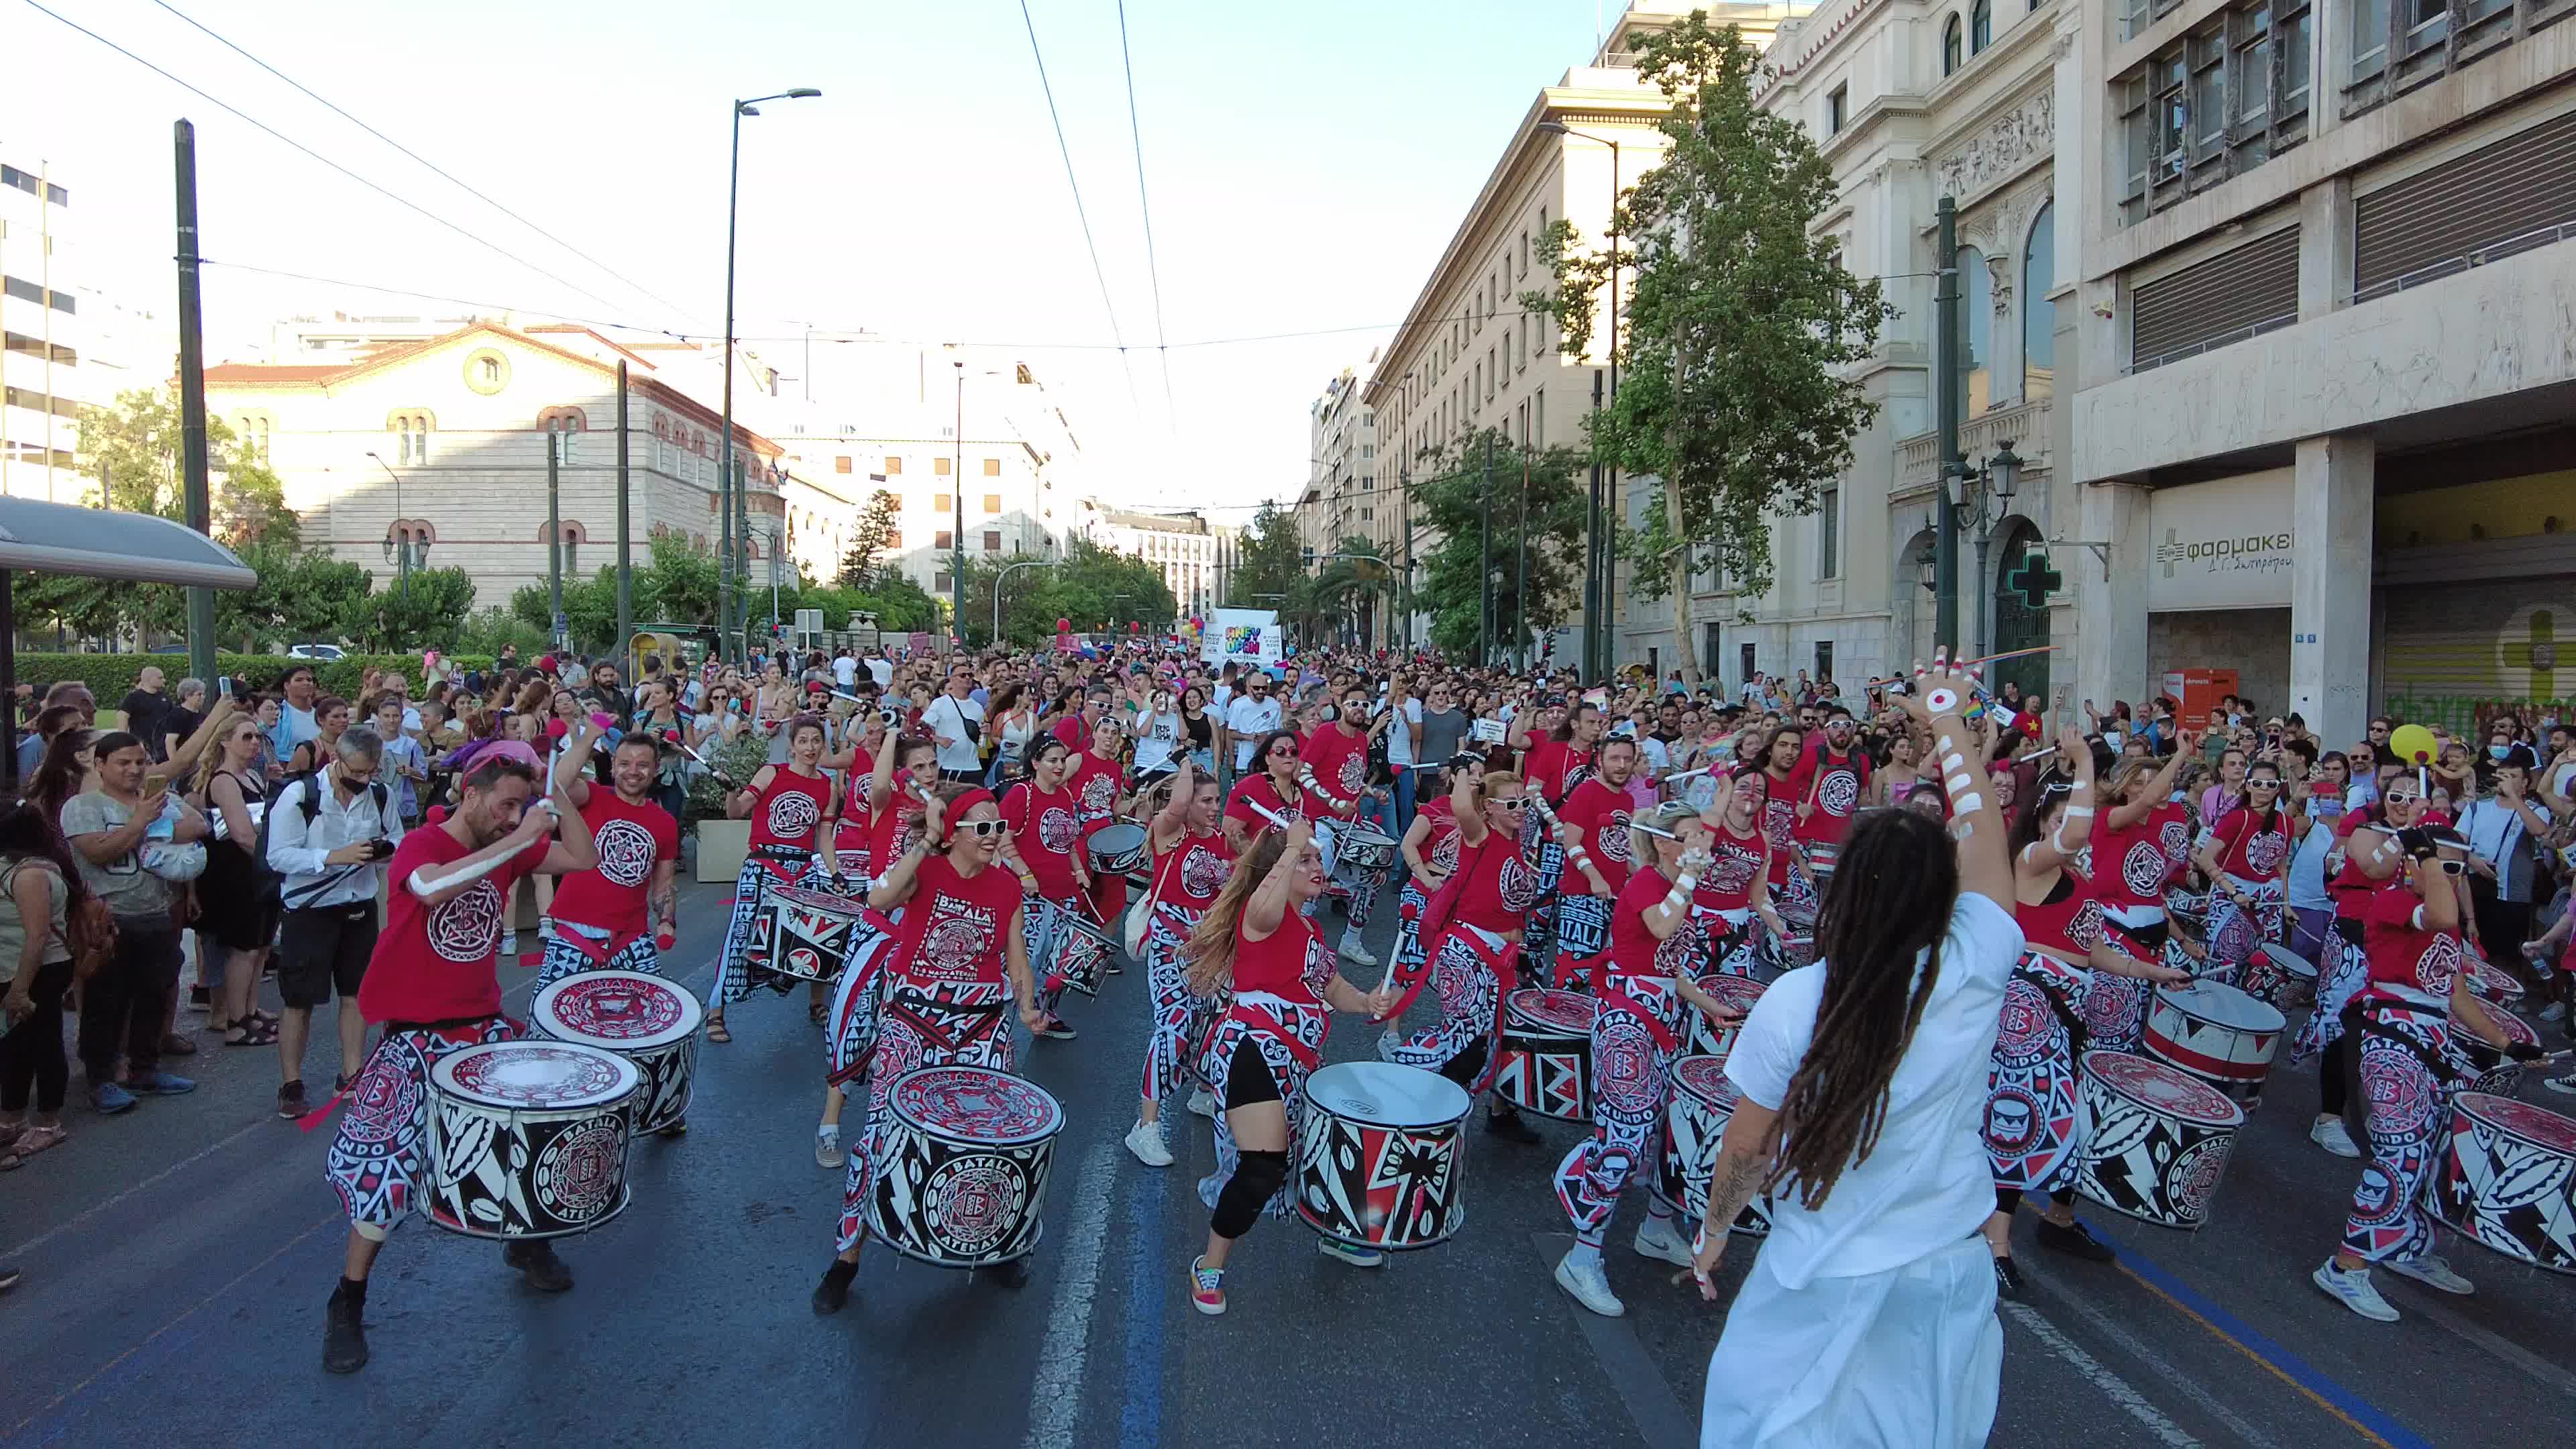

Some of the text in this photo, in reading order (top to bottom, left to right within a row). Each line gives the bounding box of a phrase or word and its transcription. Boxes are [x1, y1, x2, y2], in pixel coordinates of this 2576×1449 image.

[1598, 1102, 1654, 1124] MUNDO
[953, 1157, 1012, 1175] BATALA
[941, 1234, 999, 1252] ATENAS
